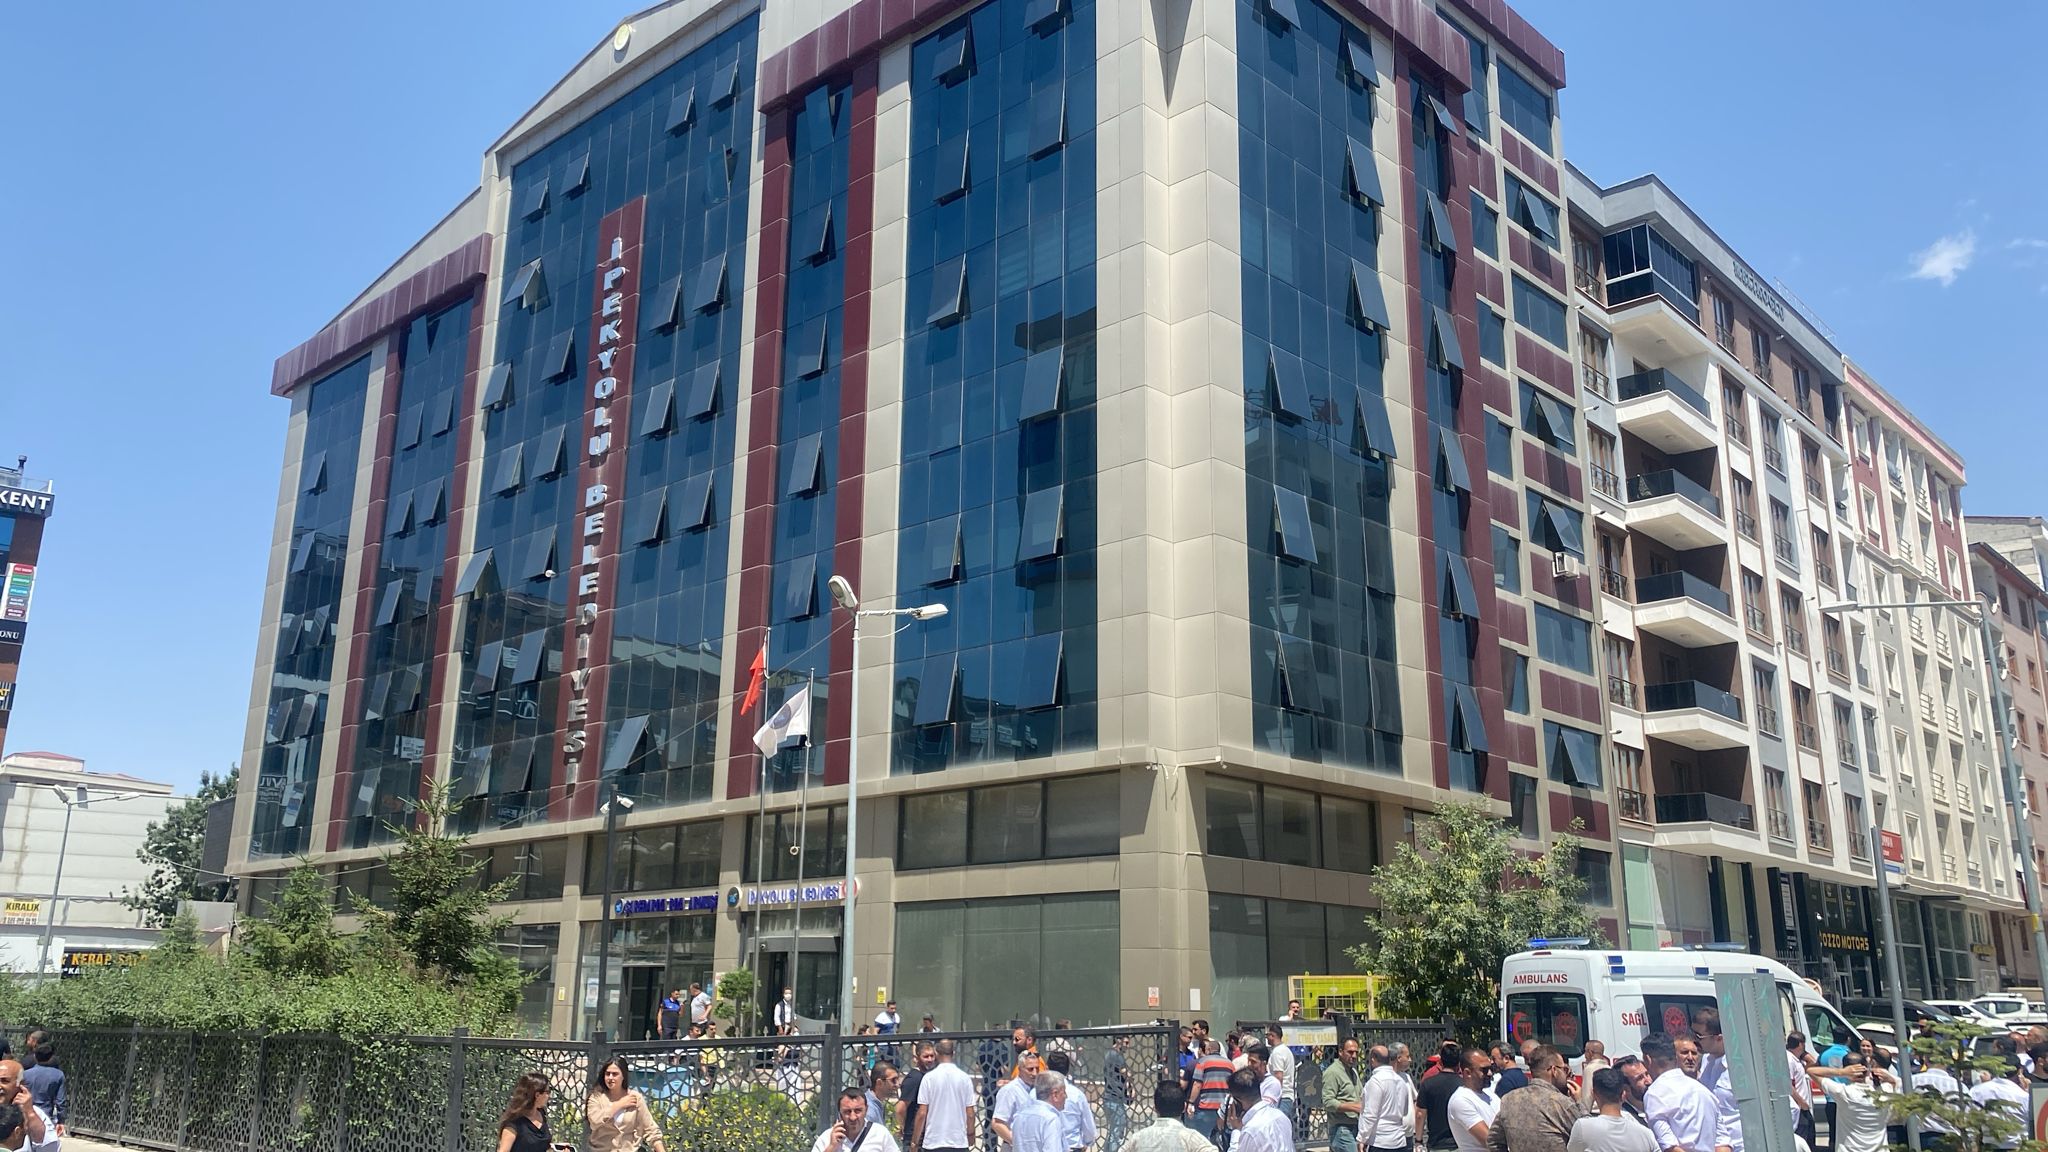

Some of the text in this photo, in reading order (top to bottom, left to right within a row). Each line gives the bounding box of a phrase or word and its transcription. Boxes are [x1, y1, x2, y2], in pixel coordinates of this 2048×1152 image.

[0, 490, 50, 510] KENT
[563, 236, 626, 785] İPEKYOLU BELEDİYESİ
[1841, 935, 1869, 951] MOTORS
[1513, 973, 1568, 985] AMBULANS
